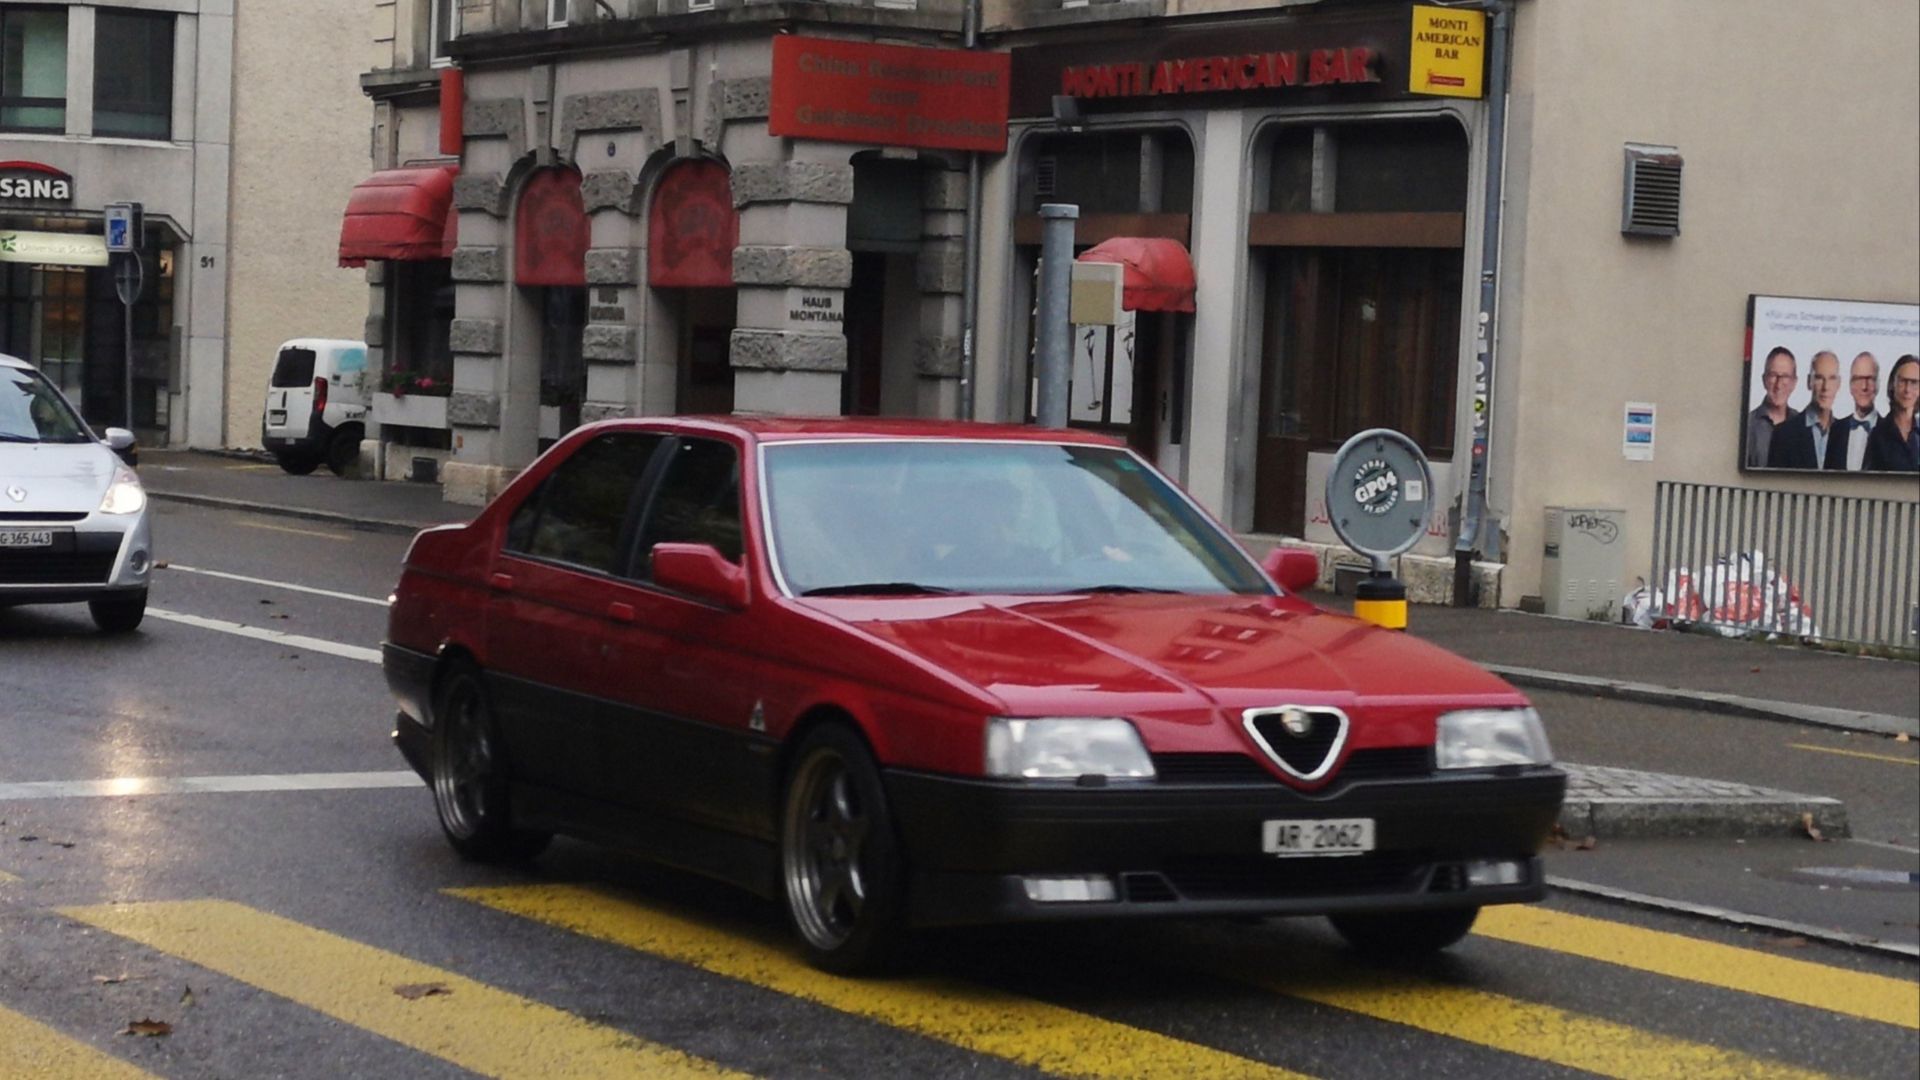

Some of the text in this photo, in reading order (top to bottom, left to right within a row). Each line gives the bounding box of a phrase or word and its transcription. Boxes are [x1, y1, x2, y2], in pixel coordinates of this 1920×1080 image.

[1429, 17, 1468, 31] MONTI
[1416, 31, 1480, 47] AMERICAN
[1434, 48, 1459, 60] BAR
[1061, 47, 1372, 98] MONTI AMERICAN BAR
[200, 256, 215, 269] 51
[802, 296, 832, 309] HAUS
[790, 310, 844, 323] MONTANA
